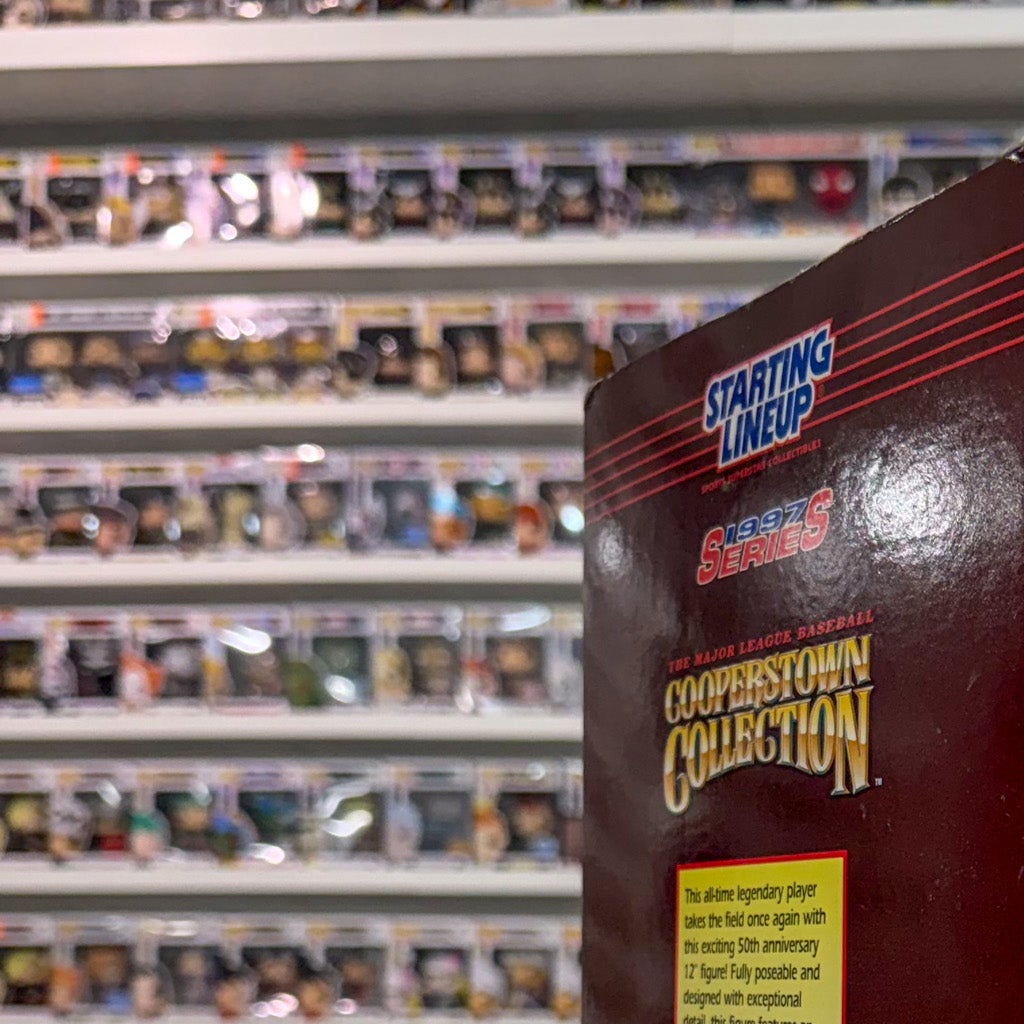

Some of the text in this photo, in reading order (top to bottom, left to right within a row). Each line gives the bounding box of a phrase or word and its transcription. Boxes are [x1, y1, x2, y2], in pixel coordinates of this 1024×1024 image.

[705, 325, 834, 430] STARTING
[719, 382, 814, 466] LINEUP
[697, 488, 834, 585] SERIES
[724, 498, 808, 546] 1997
[668, 609, 875, 673] THE MAJOR LEAGUE BASEBALL
[664, 633, 873, 724] COOPERSTOWN
[663, 685, 875, 815] COLLECTION
[685, 882, 817, 906] This all-time legendary player
[685, 908, 826, 931] takes the field once again with
[684, 935, 820, 959] this exciting 50th anniversary
[700, 963, 728, 985] figure!
[730, 963, 751, 985] Fully
[755, 963, 797, 984] poseable
[800, 963, 821, 981] and
[683, 989, 802, 1012] designed with exceptional
